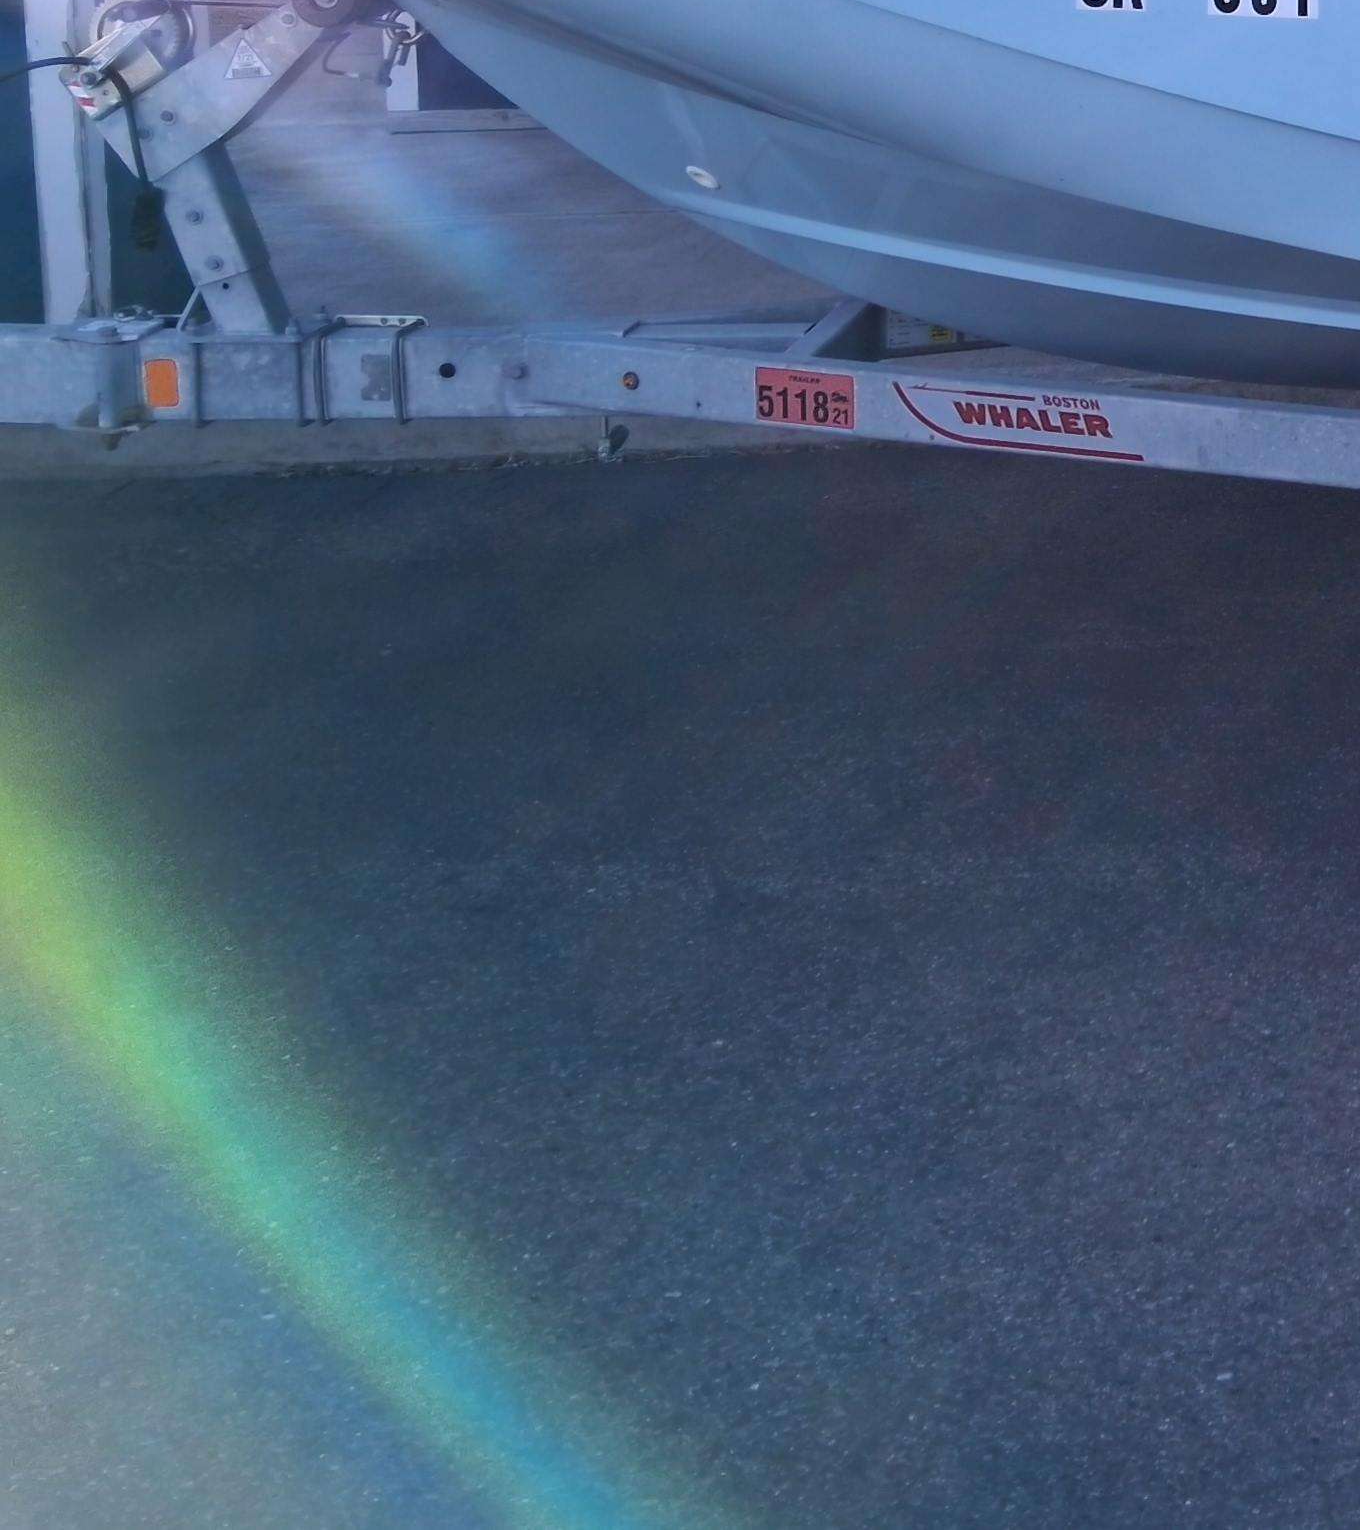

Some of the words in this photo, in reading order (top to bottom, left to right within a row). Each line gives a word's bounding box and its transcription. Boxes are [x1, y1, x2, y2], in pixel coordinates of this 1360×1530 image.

[758, 385, 829, 423] 5118
[832, 408, 848, 425] 21
[953, 401, 1113, 438] WHALER
[1042, 395, 1101, 410] BOSTON
